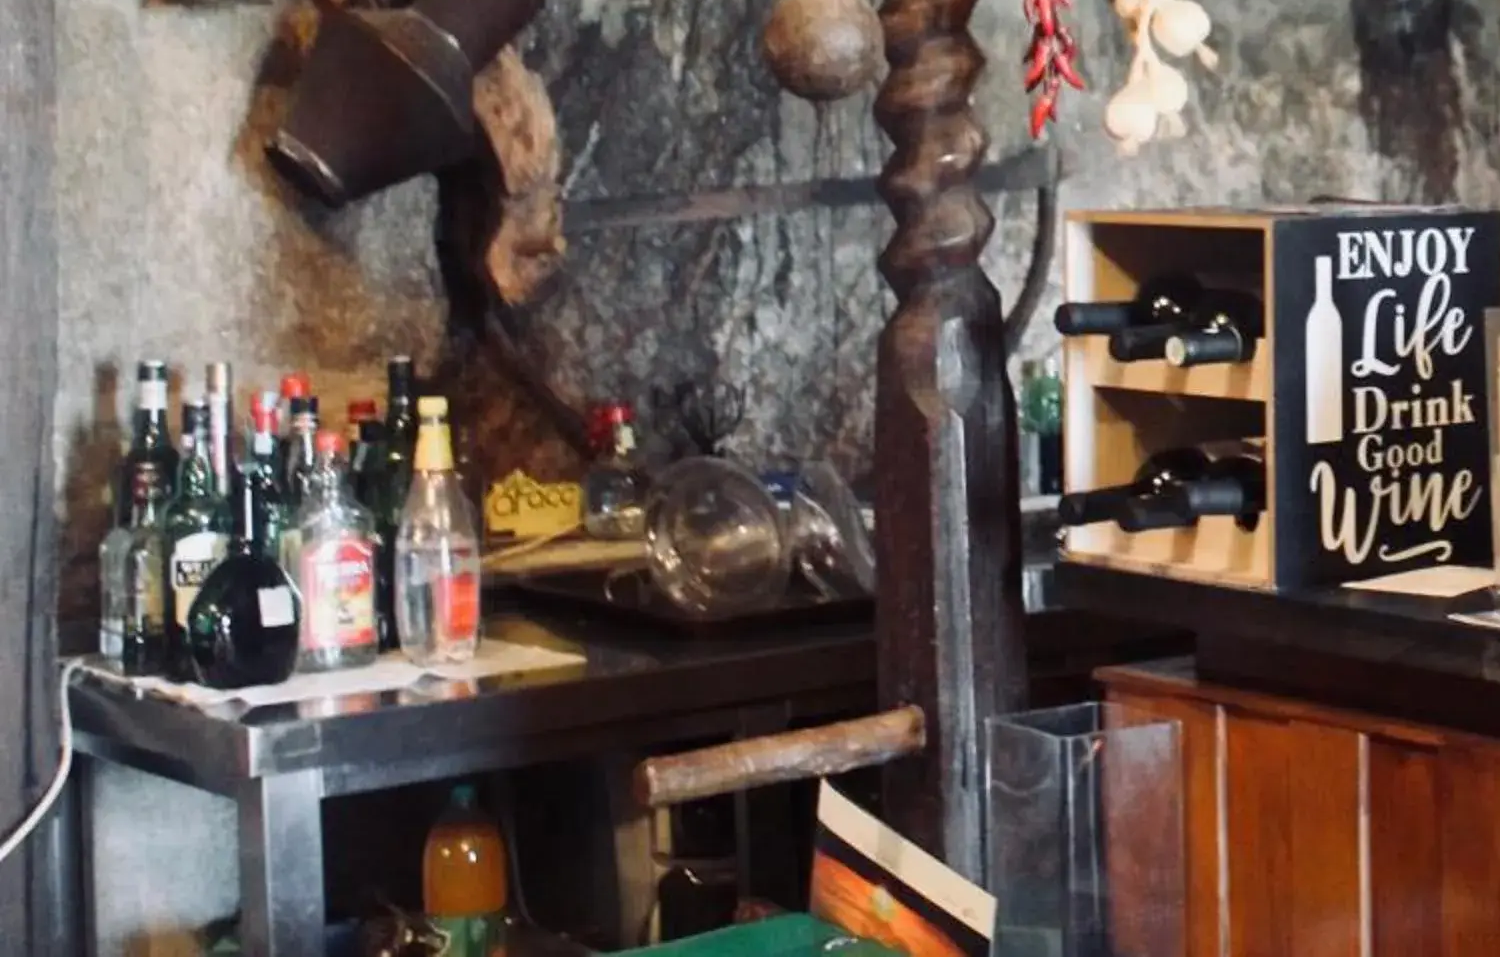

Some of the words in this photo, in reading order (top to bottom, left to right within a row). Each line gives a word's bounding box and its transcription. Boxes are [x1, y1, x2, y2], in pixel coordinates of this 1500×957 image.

[1336, 227, 1475, 279] ENJOY
[1351, 272, 1473, 380] Life
[1352, 379, 1475, 433] Drink
[1357, 429, 1444, 472] Good
[1310, 460, 1482, 565] Wine
